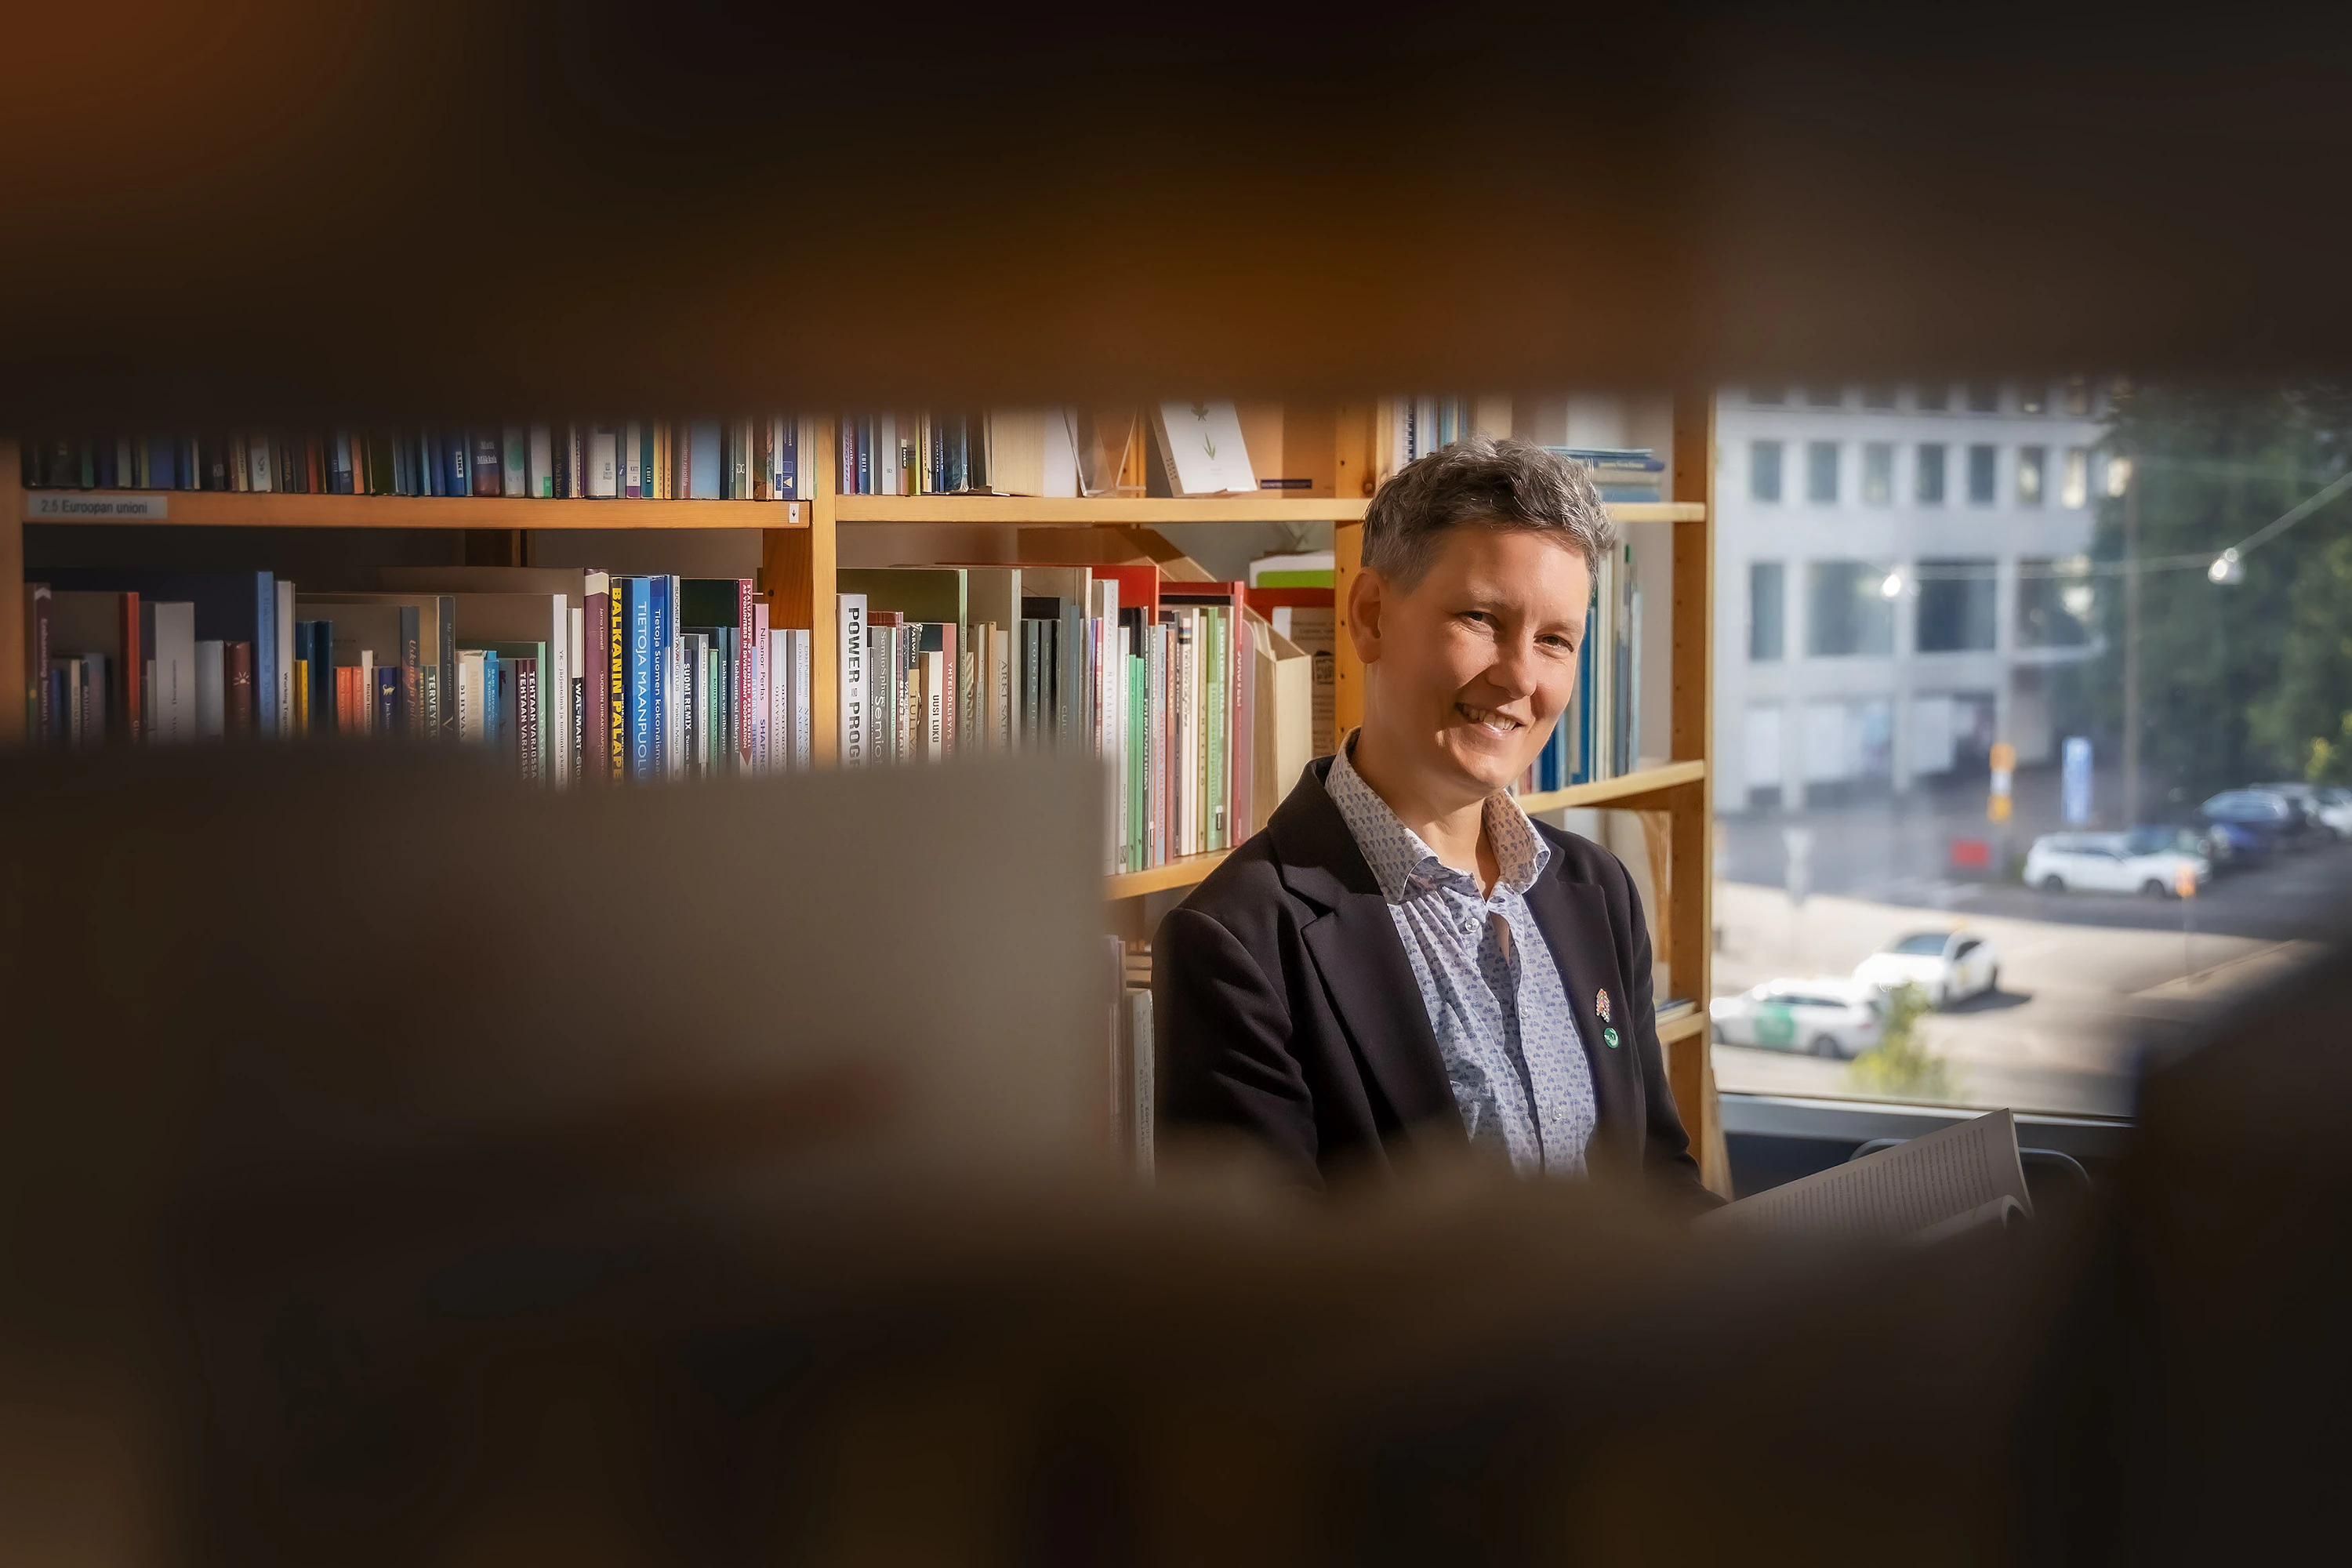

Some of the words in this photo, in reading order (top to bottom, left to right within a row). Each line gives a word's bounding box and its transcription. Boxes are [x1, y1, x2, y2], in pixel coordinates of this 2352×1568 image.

[62, 499, 114, 515] Euroopan
[116, 500, 148, 514] unioni
[39, 618, 49, 678] Enhancing
[612, 587, 622, 694] BALKANIN
[636, 601, 648, 666] TIETOJA
[848, 607, 860, 684] POWER
[408, 640, 418, 684] Uskonto
[408, 685, 417, 697] ja
[428, 673, 437, 727] TERVEYS
[459, 684, 466, 695] 51
[519, 671, 528, 722] TEHTAAN
[931, 695, 940, 716] UUSI
[931, 720, 940, 743] LUKU
